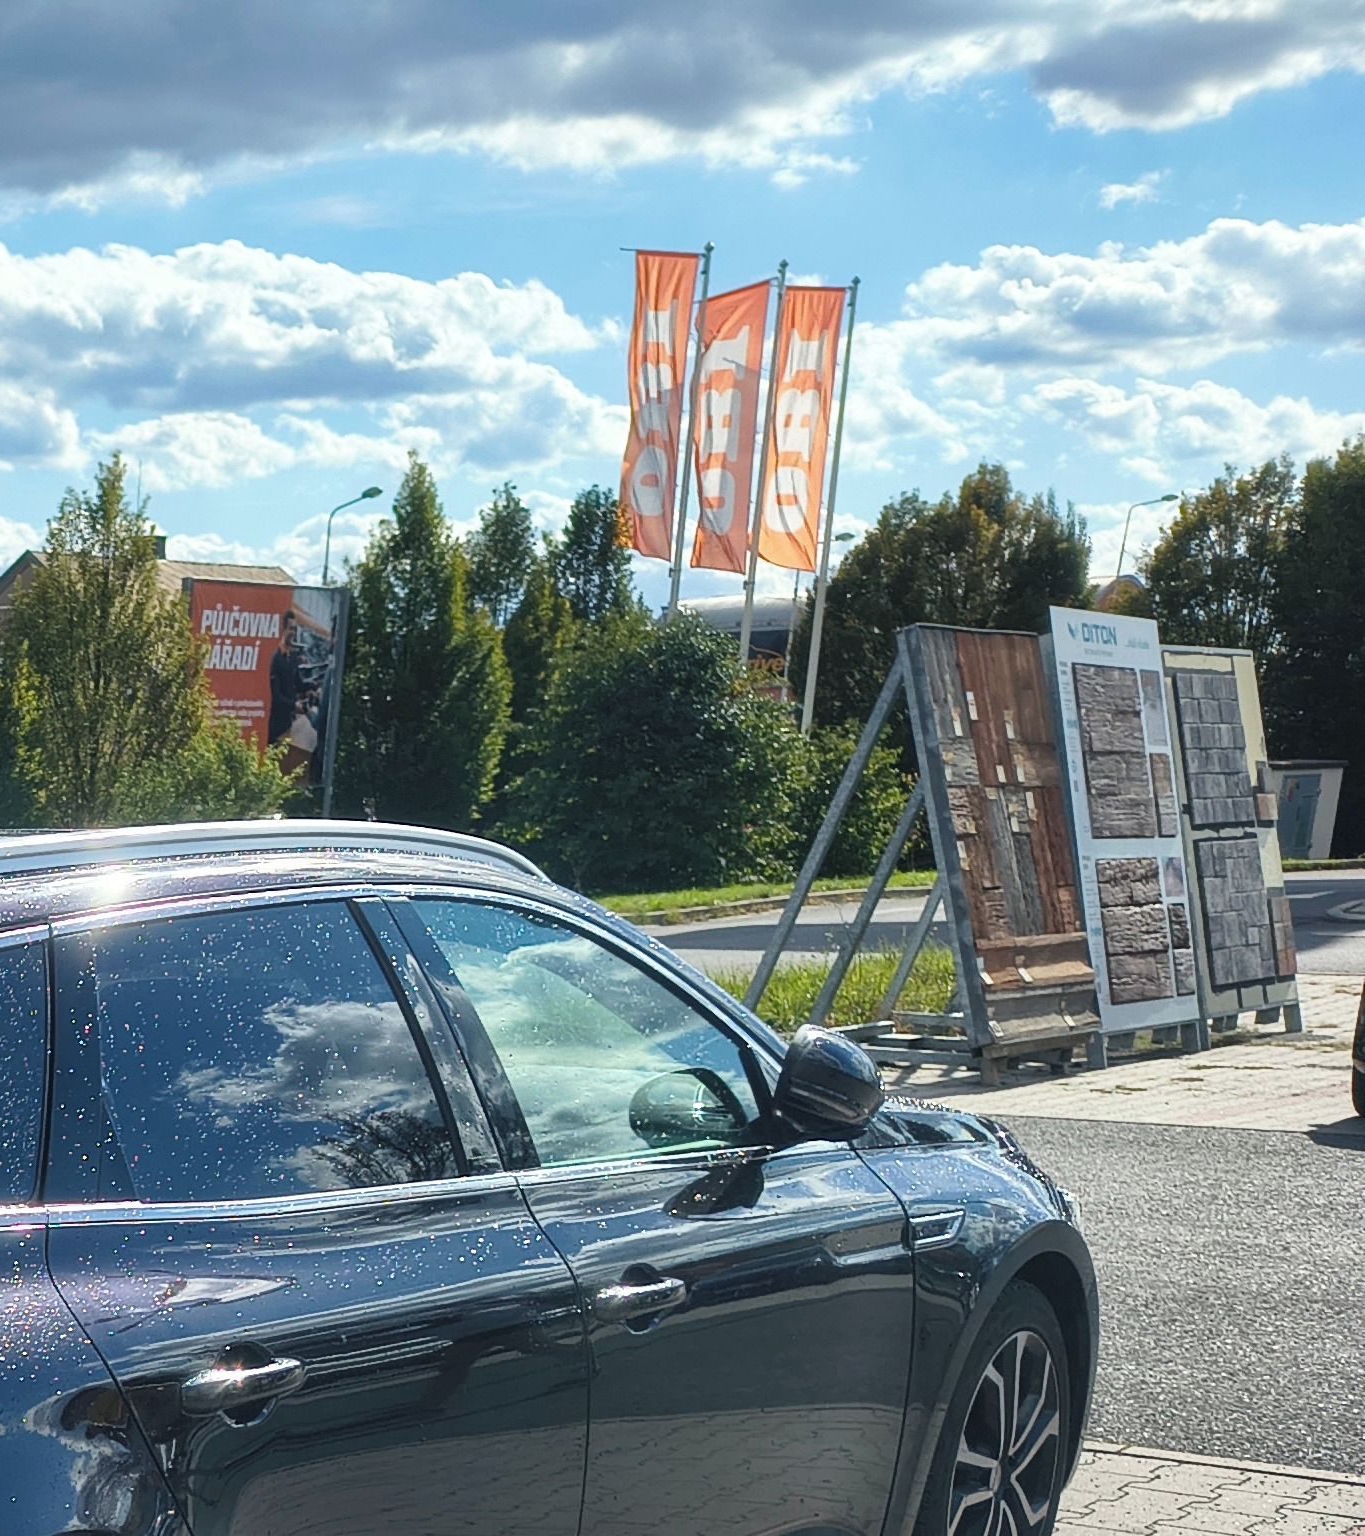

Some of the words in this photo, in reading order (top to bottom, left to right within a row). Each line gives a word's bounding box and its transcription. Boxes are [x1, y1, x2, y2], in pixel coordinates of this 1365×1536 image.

[700, 324, 750, 537] OBI
[764, 327, 830, 533] OBI
[200, 602, 281, 639] PŮJČOVNA
[204, 638, 262, 671] ÁŘADÍ
